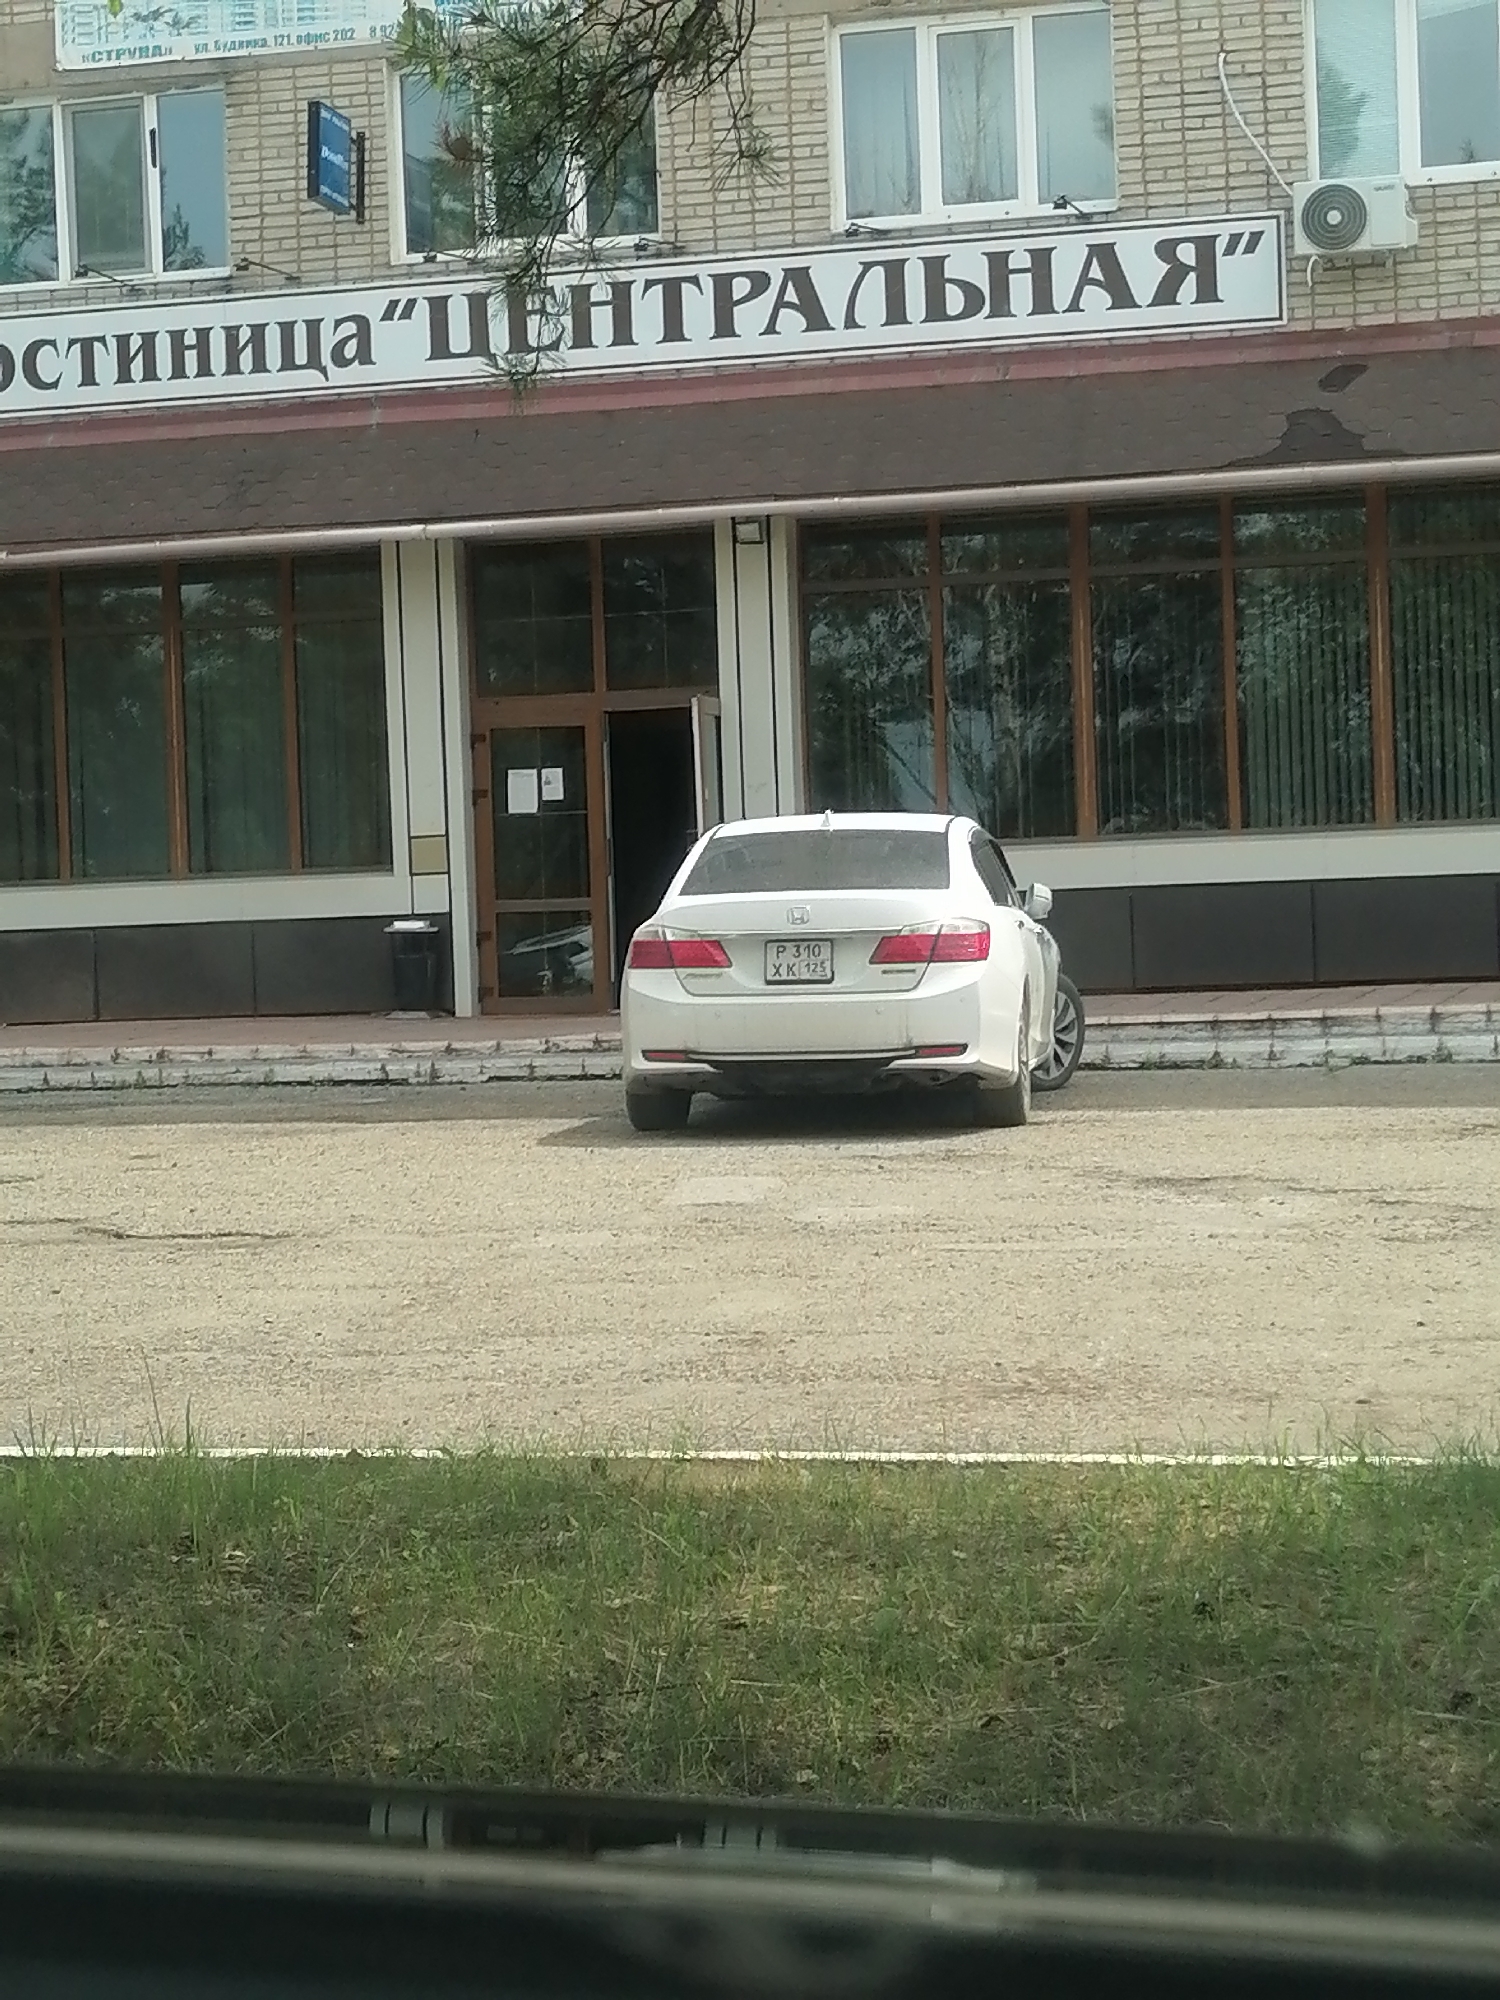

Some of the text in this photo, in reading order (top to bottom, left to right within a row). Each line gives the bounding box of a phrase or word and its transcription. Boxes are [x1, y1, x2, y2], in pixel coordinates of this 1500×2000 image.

[296, 30, 331, 46] офис
[332, 27, 356, 42] 202
[792, 943, 822, 959] 310
